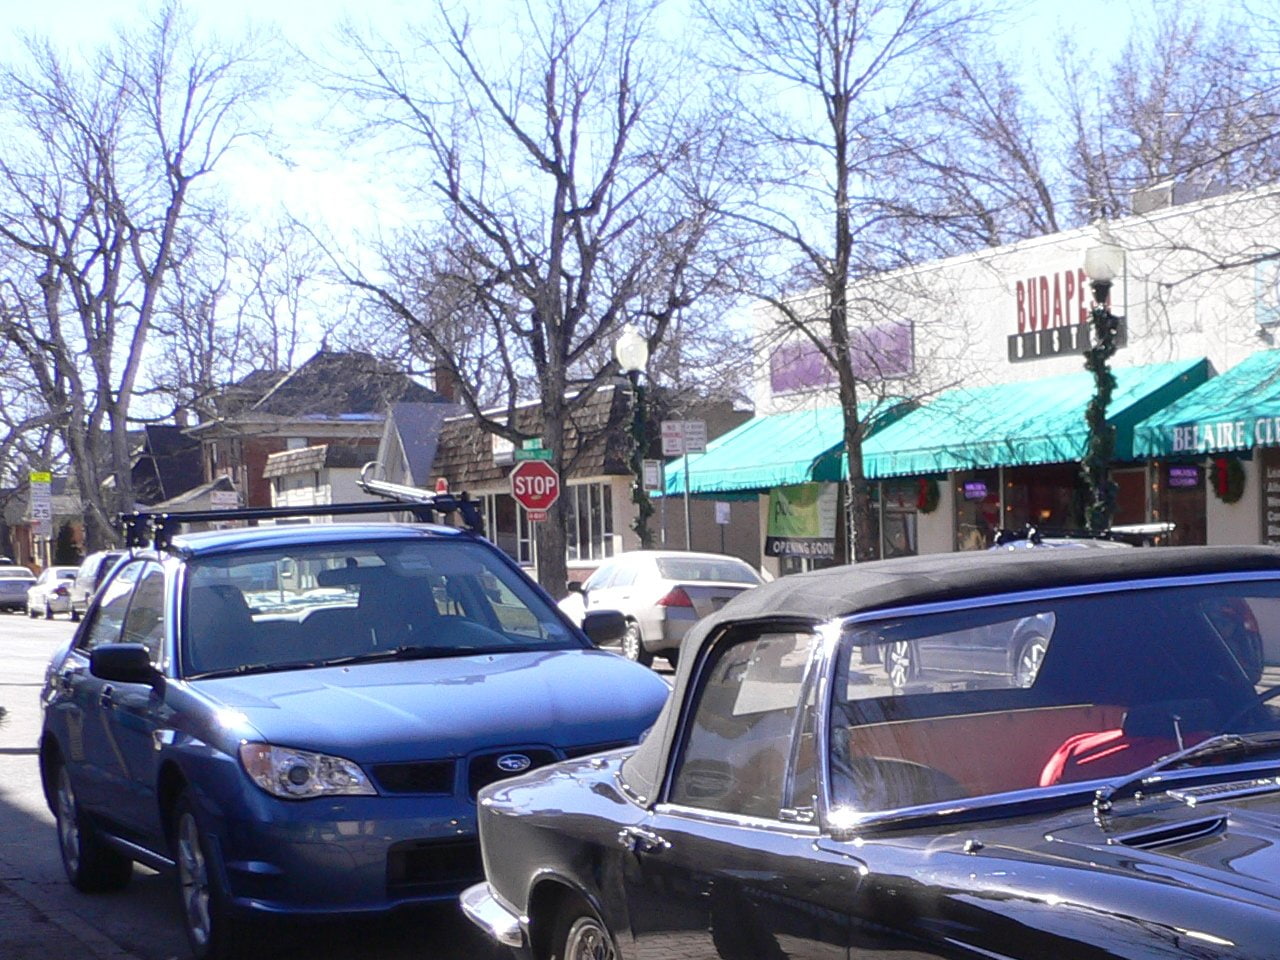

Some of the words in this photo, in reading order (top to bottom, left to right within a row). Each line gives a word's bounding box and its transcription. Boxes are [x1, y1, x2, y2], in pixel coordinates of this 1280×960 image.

[1016, 267, 1111, 334] BUDAPE
[1017, 325, 1099, 358] BISTR
[1173, 421, 1246, 452] BELAIRE
[515, 476, 556, 495] STOP
[34, 508, 49, 518] 25
[772, 541, 810, 554] OPENING
